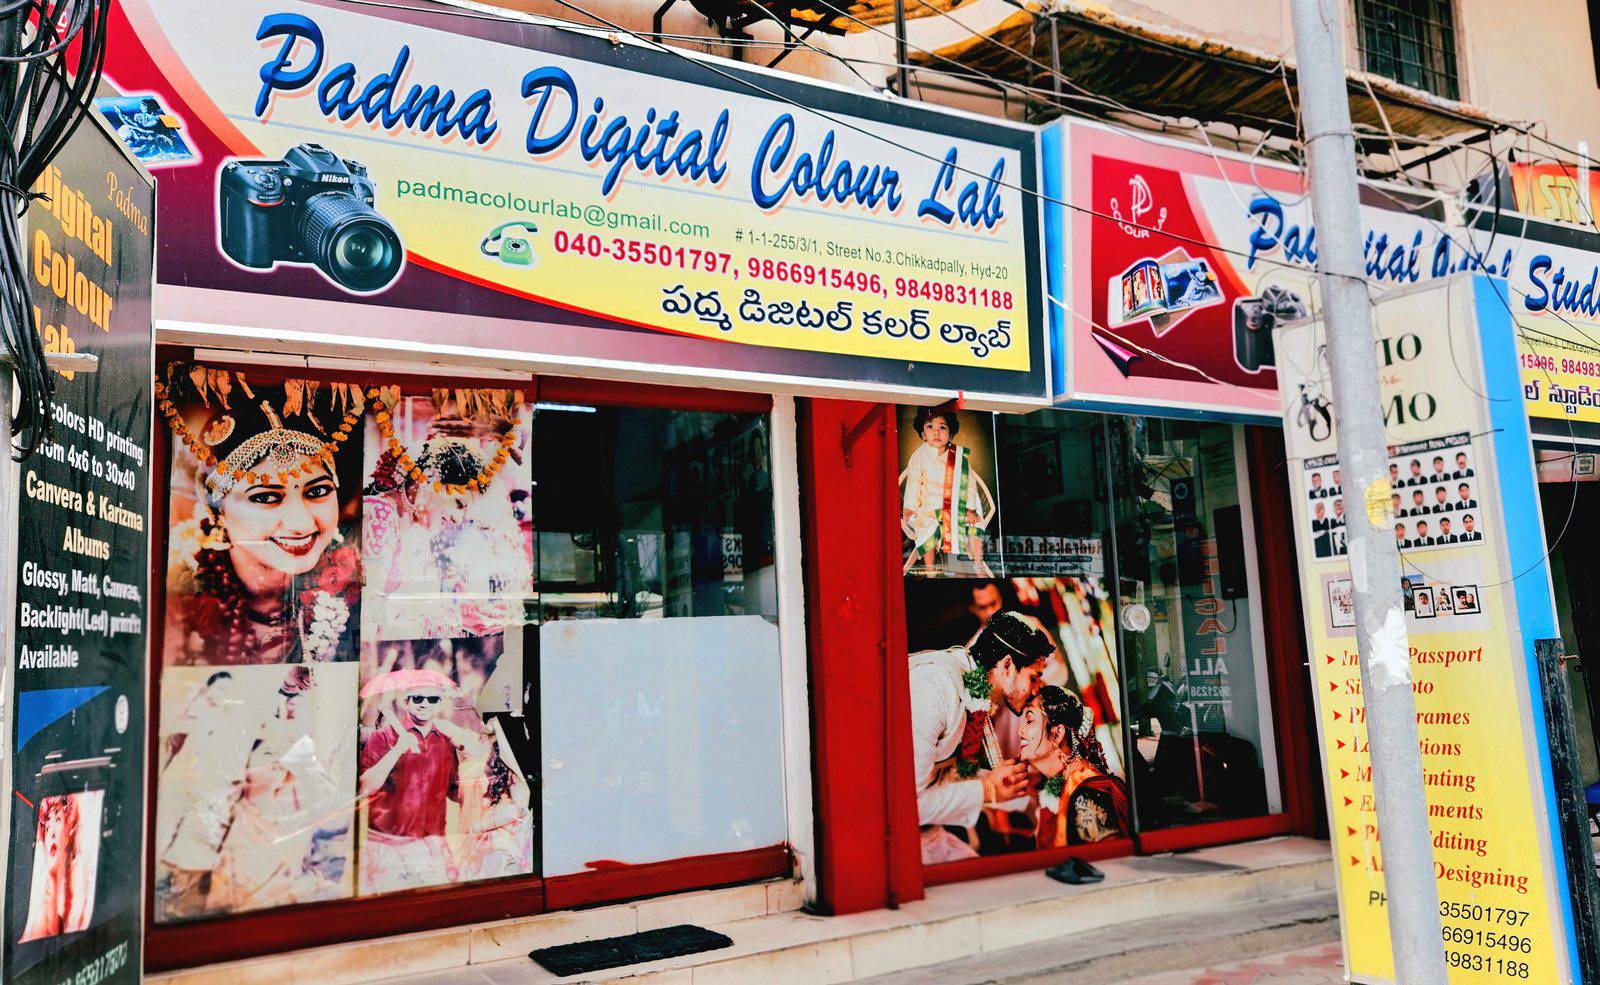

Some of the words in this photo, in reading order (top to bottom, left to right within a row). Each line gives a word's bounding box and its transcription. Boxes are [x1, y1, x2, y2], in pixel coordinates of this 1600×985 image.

[255, 13, 498, 145] Padma
[521, 66, 732, 198] Digital
[751, 112, 903, 212] Colour
[917, 146, 1006, 230] Lab
[321, 174, 350, 184] Nikon
[35, 163, 113, 268] Digital
[106, 171, 149, 237] Padma
[396, 179, 710, 239] padmacolourlab@gmail.com
[553, 229, 740, 280] 040-35501797,
[747, 256, 888, 299] 9866915496,
[894, 277, 1014, 311] 9849831188
[748, 229, 822, 256] 1-1-255/3/1,
[826, 241, 862, 260] Street
[971, 264, 1009, 281] Hyd-20
[33, 228, 113, 333] Colour
[1524, 254, 1600, 317] Stud
[661, 284, 733, 332] పద్మ
[739, 288, 853, 332] డిజిటల్
[862, 308, 932, 341] కలర్
[939, 320, 1012, 359] ల్యాబ్
[88, 416, 105, 443] HD
[106, 430, 144, 468] printing
[67, 444, 90, 473] 4x6
[91, 454, 103, 478] to
[105, 460, 136, 492] 30x40
[25, 469, 83, 513] Canvera
[86, 490, 96, 517] &
[99, 494, 144, 532] Karizma
[63, 525, 110, 560] Albums
[22, 561, 69, 597] Glossy,
[71, 568, 101, 600] Matt,
[20, 602, 109, 637] Backlight(Led)
[19, 644, 80, 670] Available
[1342, 649, 1359, 667] In
[1408, 646, 1483, 668] Passport
[1345, 678, 1362, 696] Si
[1416, 711, 1471, 726] rames
[1418, 738, 1462, 757] tions
[1422, 769, 1477, 793] inting
[1428, 803, 1484, 821] ments
[1430, 830, 1489, 858] diting
[1439, 900, 1531, 928] 35501797
[1441, 925, 1533, 954] 66915496
